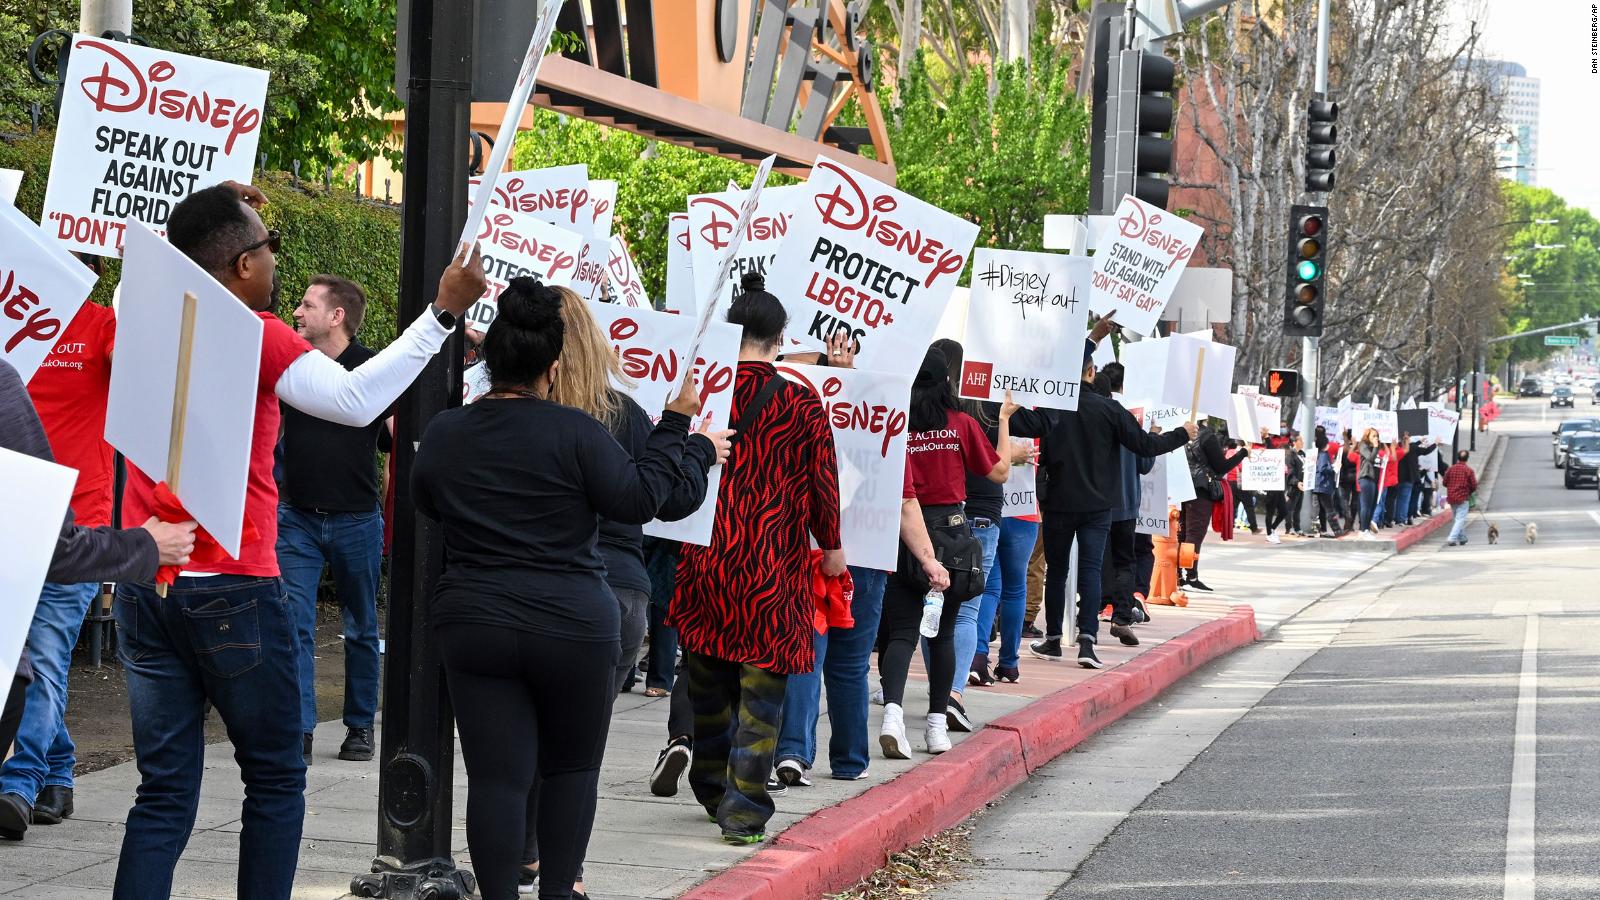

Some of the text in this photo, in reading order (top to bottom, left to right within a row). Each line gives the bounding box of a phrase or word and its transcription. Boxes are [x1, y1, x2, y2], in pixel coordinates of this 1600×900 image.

[95, 125, 219, 172] SPEAK OUT
[102, 159, 200, 197] AGAINST
[90, 187, 178, 226] FLORID
[690, 197, 793, 250] DISN
[482, 254, 543, 283] OTECT
[719, 255, 768, 280] PEAK
[809, 236, 921, 305] PROTECT
[1103, 258, 1159, 294] US AGAINST
[1109, 242, 1169, 279] STAND WITH
[978, 260, 1051, 298] #Disney
[1116, 284, 1138, 304] SAY
[0, 269, 61, 354] NEY
[804, 271, 894, 329] LBGTQ+
[1051, 286, 1080, 314] out
[39, 358, 83, 370] eakOut.org
[57, 342, 86, 354] OUT
[965, 372, 1079, 398] AHF SPEAK OUT
[776, 366, 906, 458] ISNEY
[1145, 407, 1178, 421] SPEAK
[914, 429, 960, 441] ACTION.
[1010, 490, 1035, 506] OUT
[1146, 517, 1168, 529] OUT
